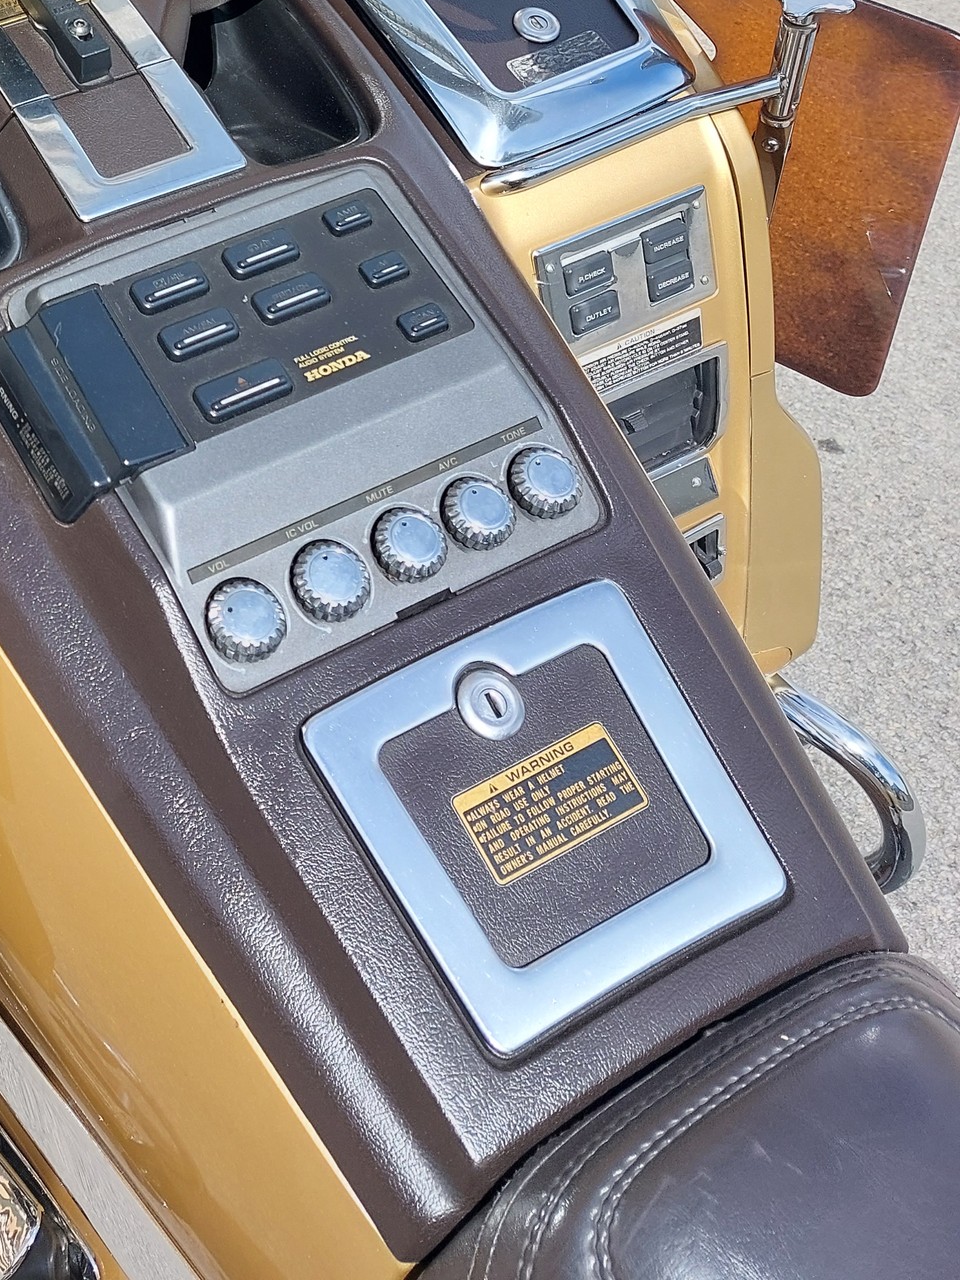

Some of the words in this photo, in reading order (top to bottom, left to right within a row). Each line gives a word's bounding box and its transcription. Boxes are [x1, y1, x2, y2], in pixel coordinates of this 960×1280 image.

[653, 235, 684, 253] INCREASE
[658, 272, 690, 289] DECREASE
[586, 306, 613, 322] OUTLET
[293, 353, 310, 364] FULL
[310, 346, 329, 357] LOGIC
[328, 335, 359, 350] CONTROL
[299, 357, 319, 368] AUDIO
[318, 347, 345, 360] SYSTEM
[624, 329, 656, 346] CAUTION
[303, 350, 371, 382] HONDA
[51, 357, 69, 384] SIDE
[65, 385, 96, 433] LOADING
[208, 559, 230, 573] VOL
[285, 528, 297, 539] IC
[298, 520, 319, 534] VOL
[365, 485, 394, 503] MUTE
[438, 457, 458, 471] AVC
[500, 426, 527, 443] TONE
[505, 741, 575, 782] WARNING
[470, 800, 500, 821] ALWAYS
[502, 786, 525, 803] WEAR
[527, 781, 535, 790] A
[536, 764, 565, 785] HELMET
[476, 820, 488, 832] ON
[490, 807, 511, 823] ROAD
[513, 798, 529, 811] USE
[531, 785, 551, 802] ONLY
[481, 821, 512, 842] FAILURE
[513, 813, 525, 825] TO
[526, 796, 556, 820] FOLLOW
[557, 780, 586, 801] PROPER
[586, 761, 622, 785] STARTING
[488, 839, 505, 854] AND
[510, 814, 551, 841] OPERATING
[555, 783, 607, 816] INSTRUCTIONS
[611, 771, 629, 786] MAY
[493, 843, 521, 865] RESULT
[525, 835, 536, 848] IN
[540, 826, 552, 839] AN
[556, 804, 594, 830] ACCIDENT.
[596, 791, 617, 808] READ
[619, 781, 635, 795] THE
[500, 851, 533, 875] OWNER'S
[535, 833, 568, 855] MANUAL
[570, 808, 612, 836] CAREFULLY.
